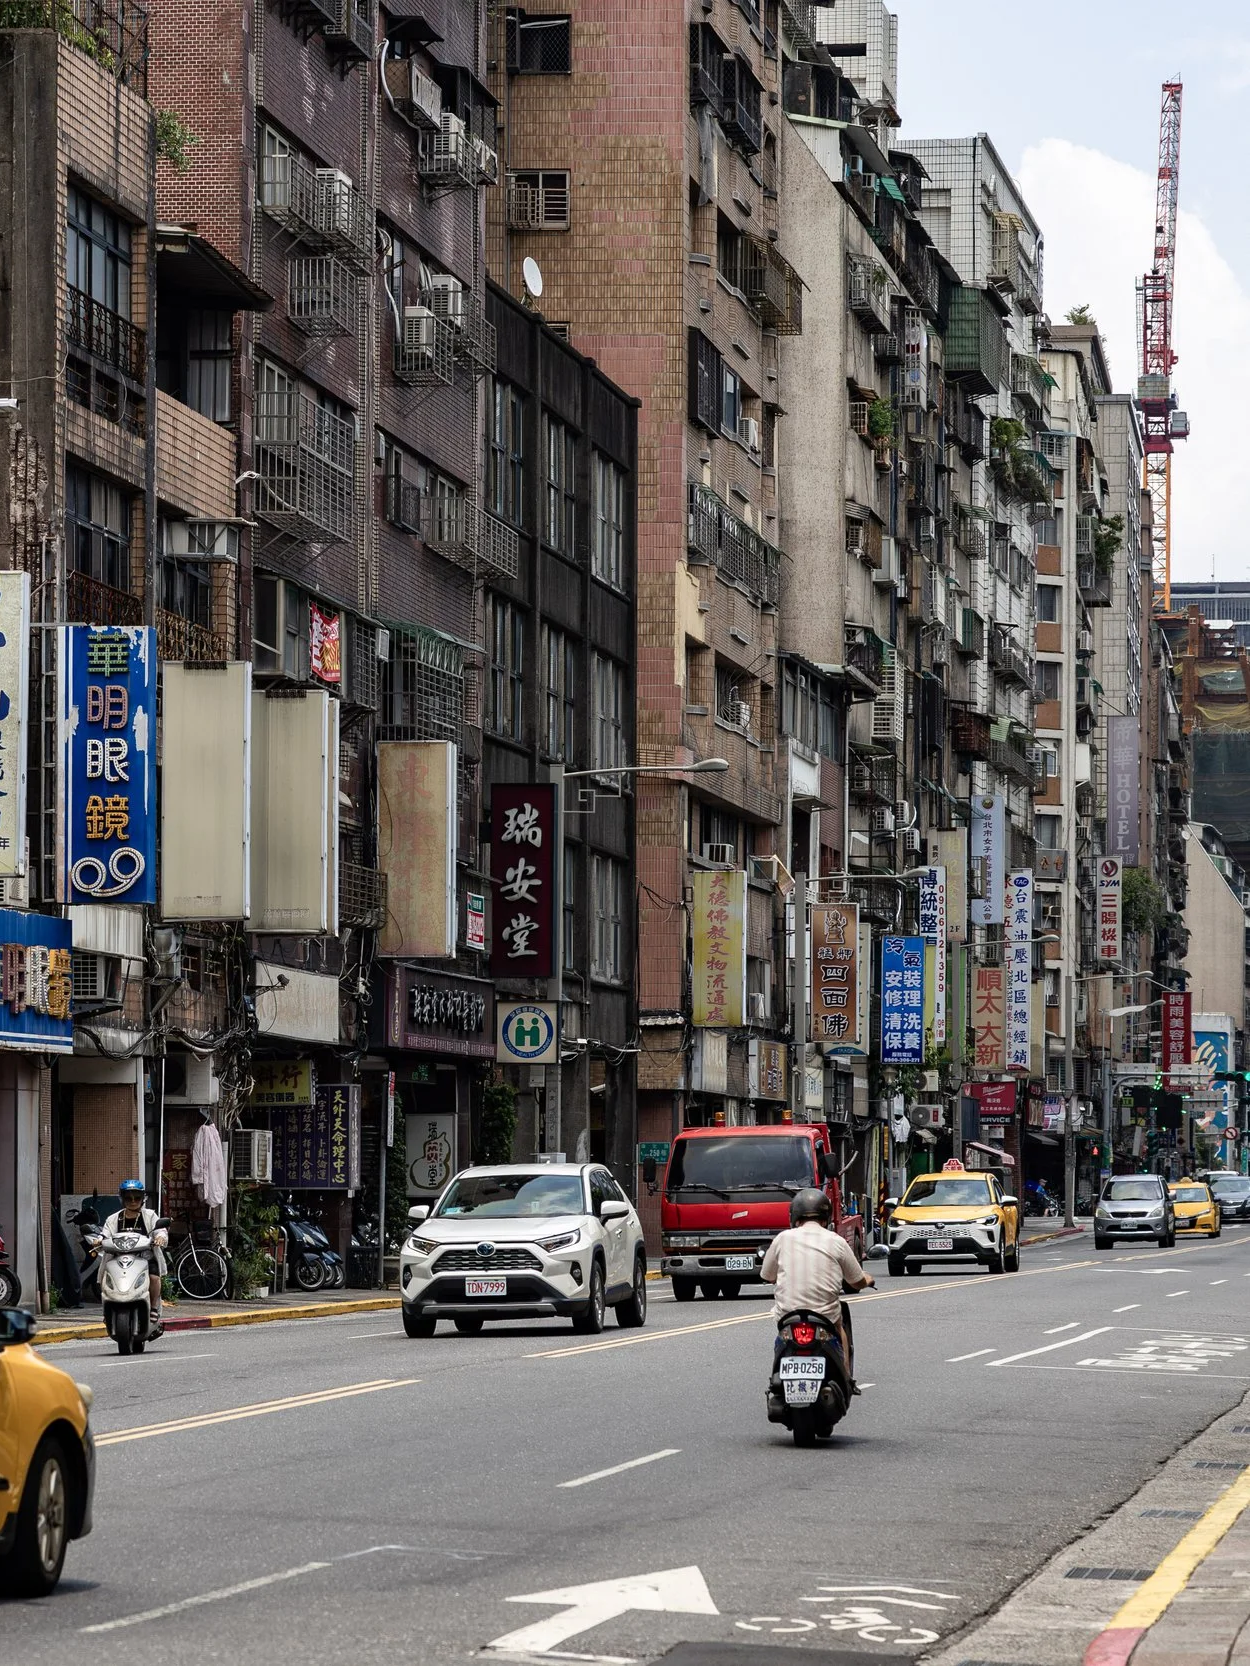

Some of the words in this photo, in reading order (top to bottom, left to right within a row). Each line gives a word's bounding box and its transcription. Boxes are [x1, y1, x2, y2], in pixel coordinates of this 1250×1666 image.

[86, 631, 130, 841] 華明眼鏡
[1116, 773, 1131, 850] HOTEL
[500, 802, 543, 959] 瑞安堂
[1015, 878, 1029, 886] TAC
[1099, 879, 1120, 888] SYM
[920, 868, 938, 946] 傳統整
[949, 925, 961, 933] 2F
[1101, 894, 1117, 958] 三陽機車
[817, 946, 853, 960] 艋舺
[885, 938, 922, 968] 冷氣
[885, 970, 922, 988] 安裝
[976, 969, 1002, 1014] 順太
[1013, 888, 1029, 1065] 台震油壓北區總經銷
[821, 964, 849, 1039] 四面佛
[884, 989, 922, 1007] 修理
[884, 1012, 922, 1030] 清洗
[1169, 994, 1185, 1064] 時雨美容舒壓
[884, 1031, 921, 1050] 保養
[976, 1021, 1002, 1065] 大新
[331, 1089, 347, 1184] 天外天命理中心
[727, 1260, 752, 1269] 029-BN
[466, 1281, 506, 1294] TDN-7999
[781, 1363, 824, 1375] MPB-0258
